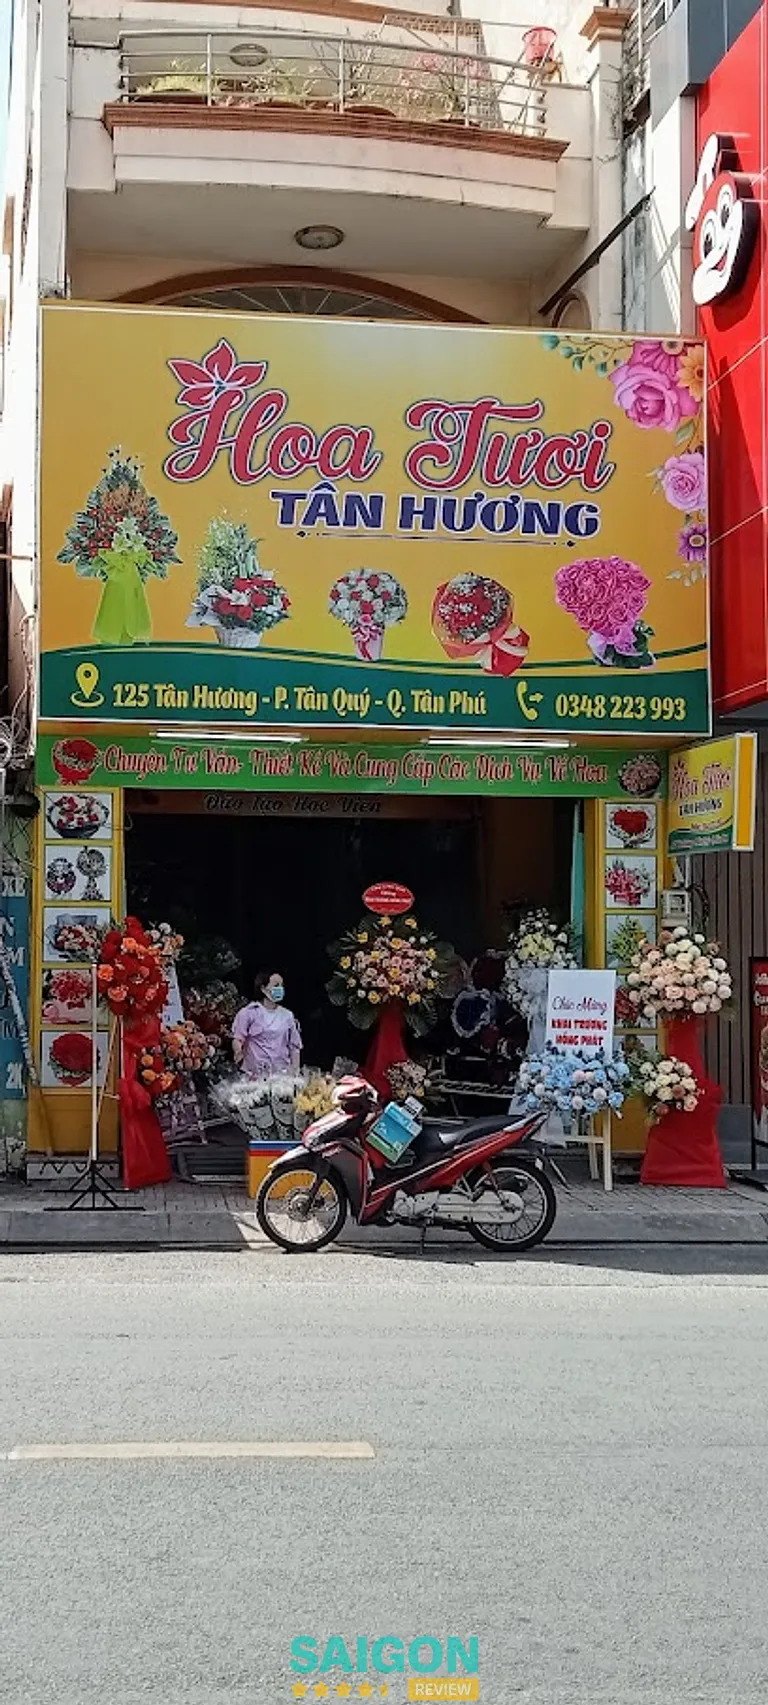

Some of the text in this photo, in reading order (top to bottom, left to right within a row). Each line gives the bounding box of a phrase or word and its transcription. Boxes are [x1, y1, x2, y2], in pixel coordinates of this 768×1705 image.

[164, 387, 616, 492] Hoa Tươi
[270, 480, 599, 538] TÂN HƯƠNG
[112, 683, 150, 707] 125
[153, 684, 189, 708] Tân
[192, 685, 258, 716] Hương
[275, 686, 290, 709] P.
[294, 686, 329, 711] Tân
[333, 687, 371, 717] Quý
[388, 689, 406, 718] Q.
[411, 689, 445, 713] Tân
[449, 691, 487, 715] Phú
[555, 693, 607, 718] 0348
[610, 695, 647, 719] 223
[650, 696, 687, 720] 993
[104, 744, 168, 781] Chuyên
[354, 750, 399, 786] Cung
[402, 750, 435, 787] Cấp
[551, 1019, 572, 1029] KHAI
